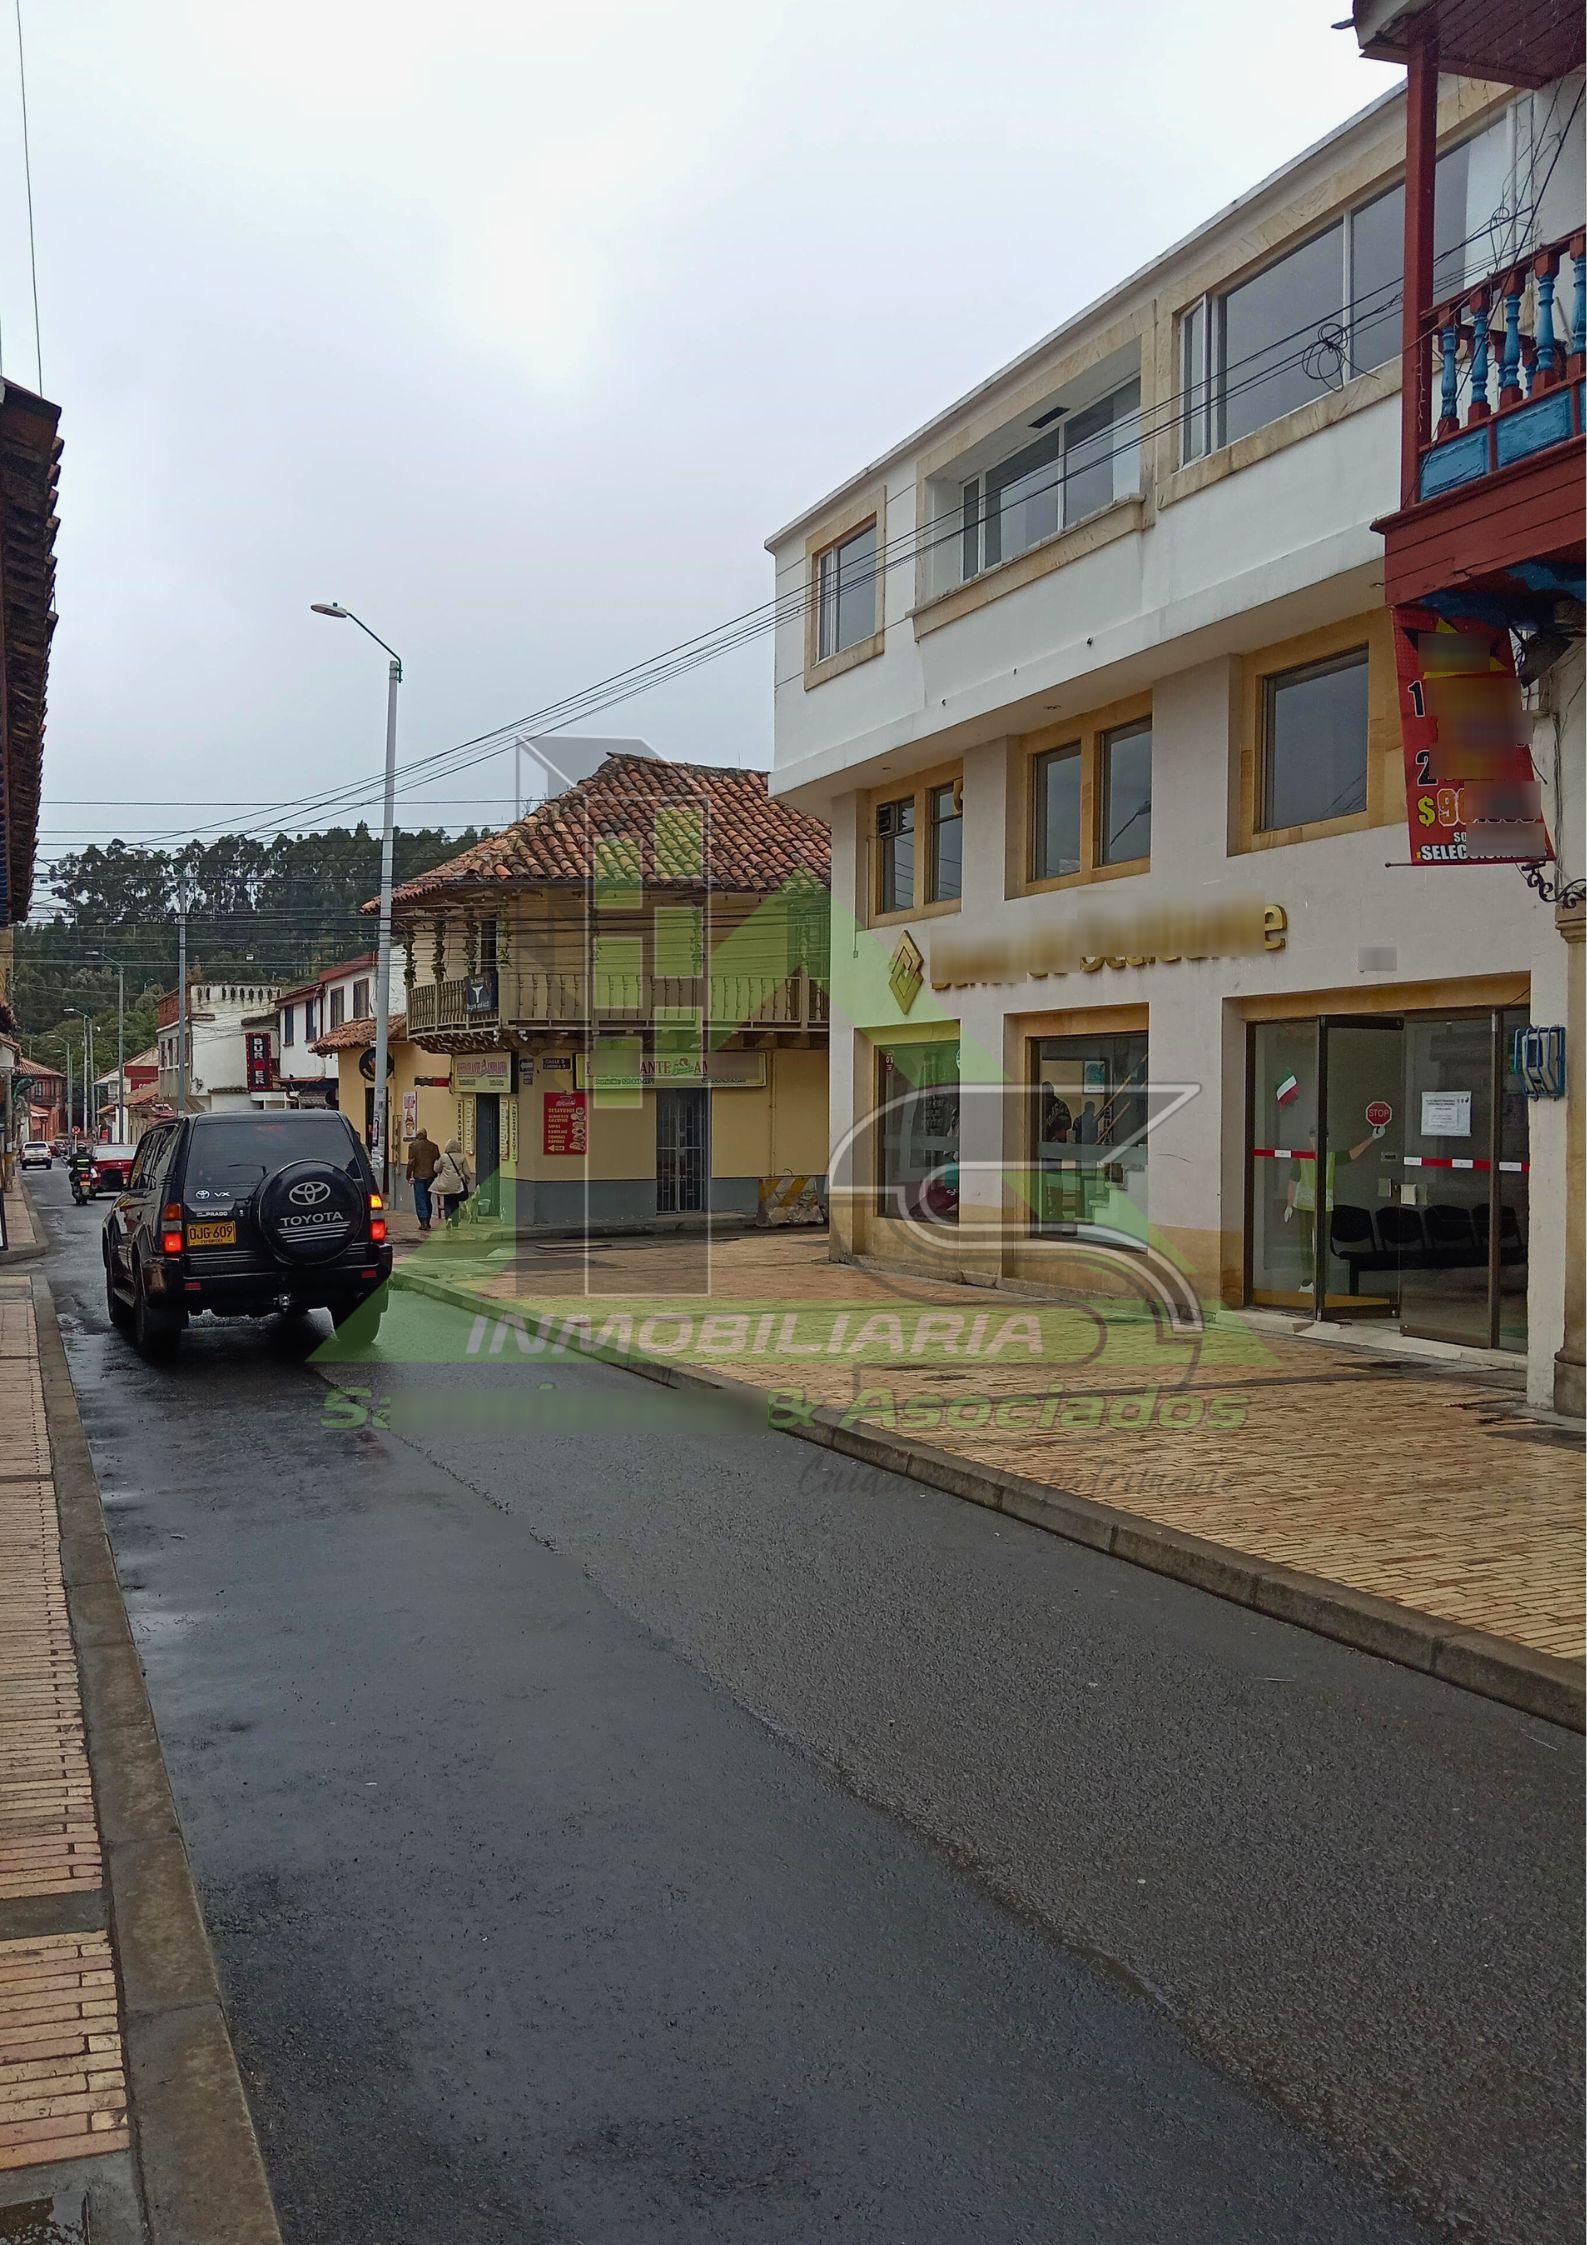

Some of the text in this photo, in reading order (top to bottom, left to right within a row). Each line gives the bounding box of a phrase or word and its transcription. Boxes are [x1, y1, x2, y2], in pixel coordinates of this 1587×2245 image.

[253, 1037, 265, 1085] BURER
[1368, 1108, 1390, 1118] STOP
[280, 1211, 344, 1228] TOYOTA
[212, 1226, 233, 1239] 609
